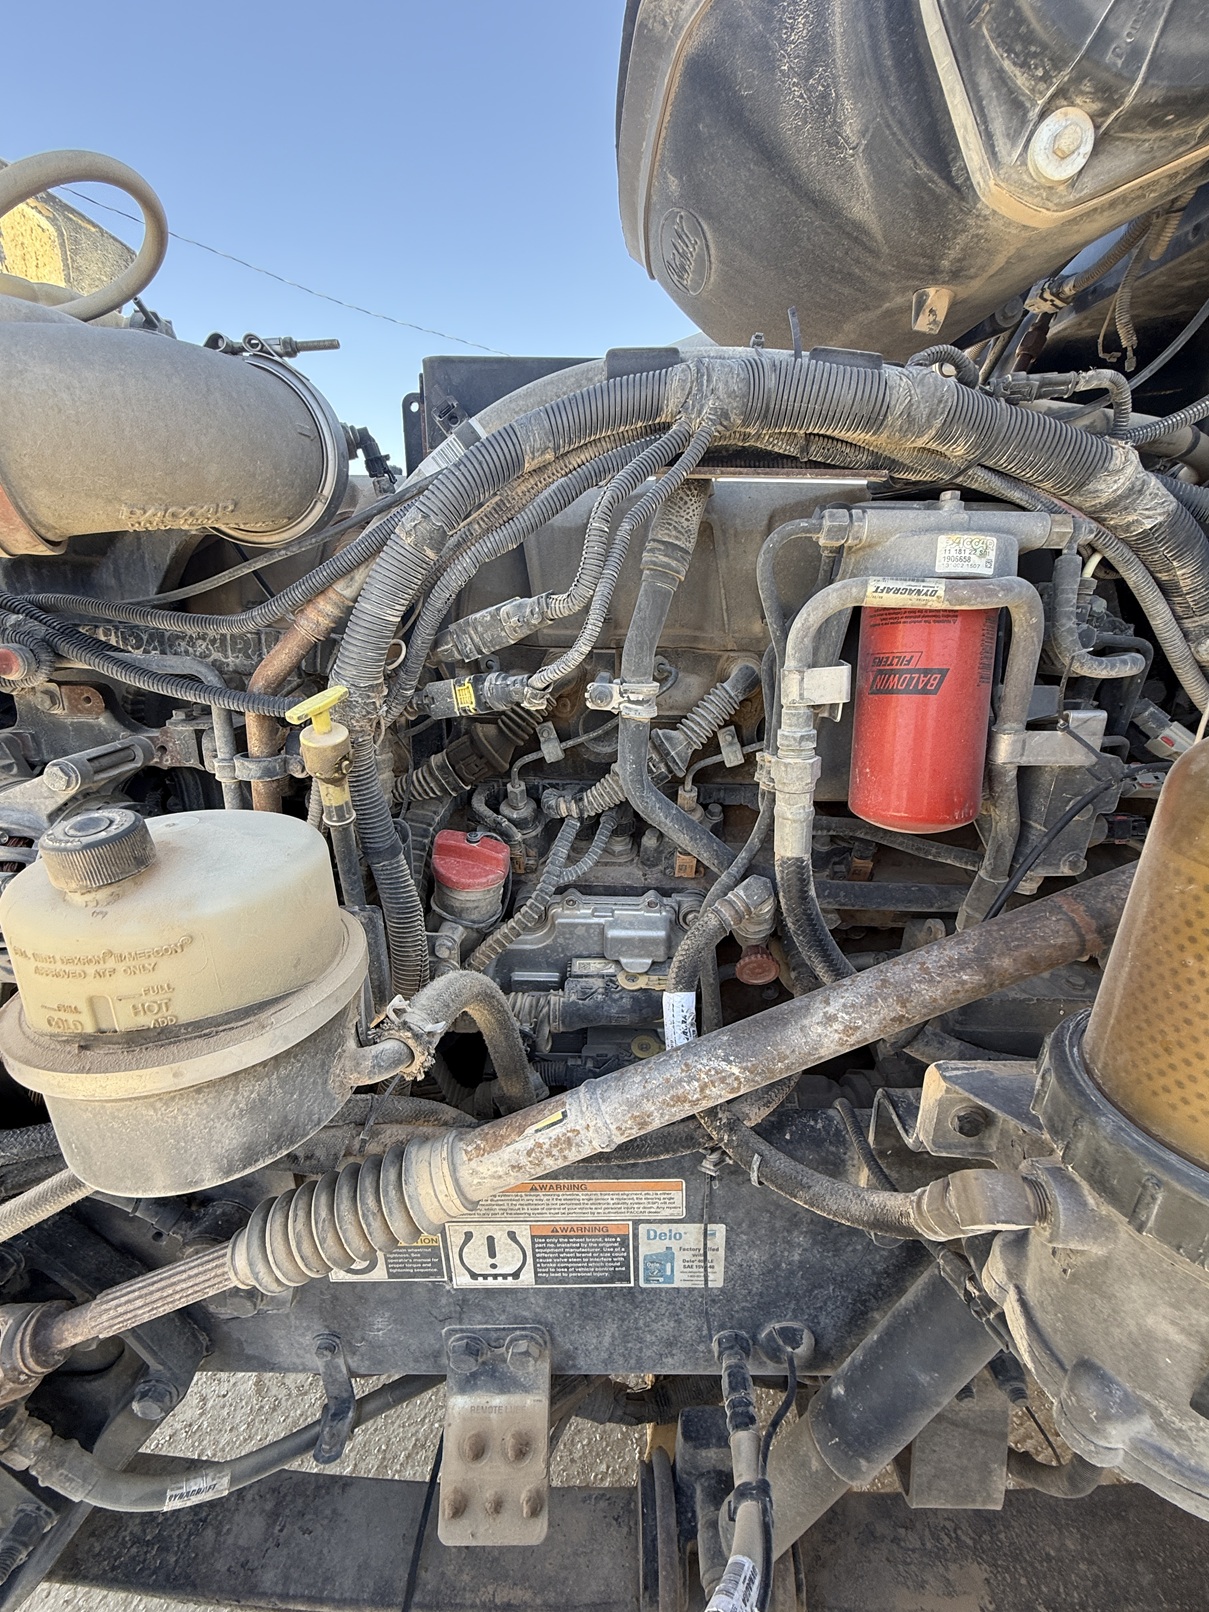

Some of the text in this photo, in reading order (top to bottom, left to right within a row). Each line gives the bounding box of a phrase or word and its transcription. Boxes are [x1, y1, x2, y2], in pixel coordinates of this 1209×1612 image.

[119, 500, 236, 521] PACCAR
[872, 585, 939, 598] DYNACRAFT
[872, 656, 914, 667] FILTERS
[874, 673, 941, 690] BALDWIN
[92, 967, 116, 979] ATF
[122, 961, 158, 977] ONLY
[142, 982, 175, 997] FULL
[131, 997, 171, 1018] HOT
[150, 1015, 178, 1030] ADD
[646, 1228, 682, 1240] Delo
[470, 1406, 504, 1414] REMOTE
[168, 1482, 218, 1502] DYNACRAFT
